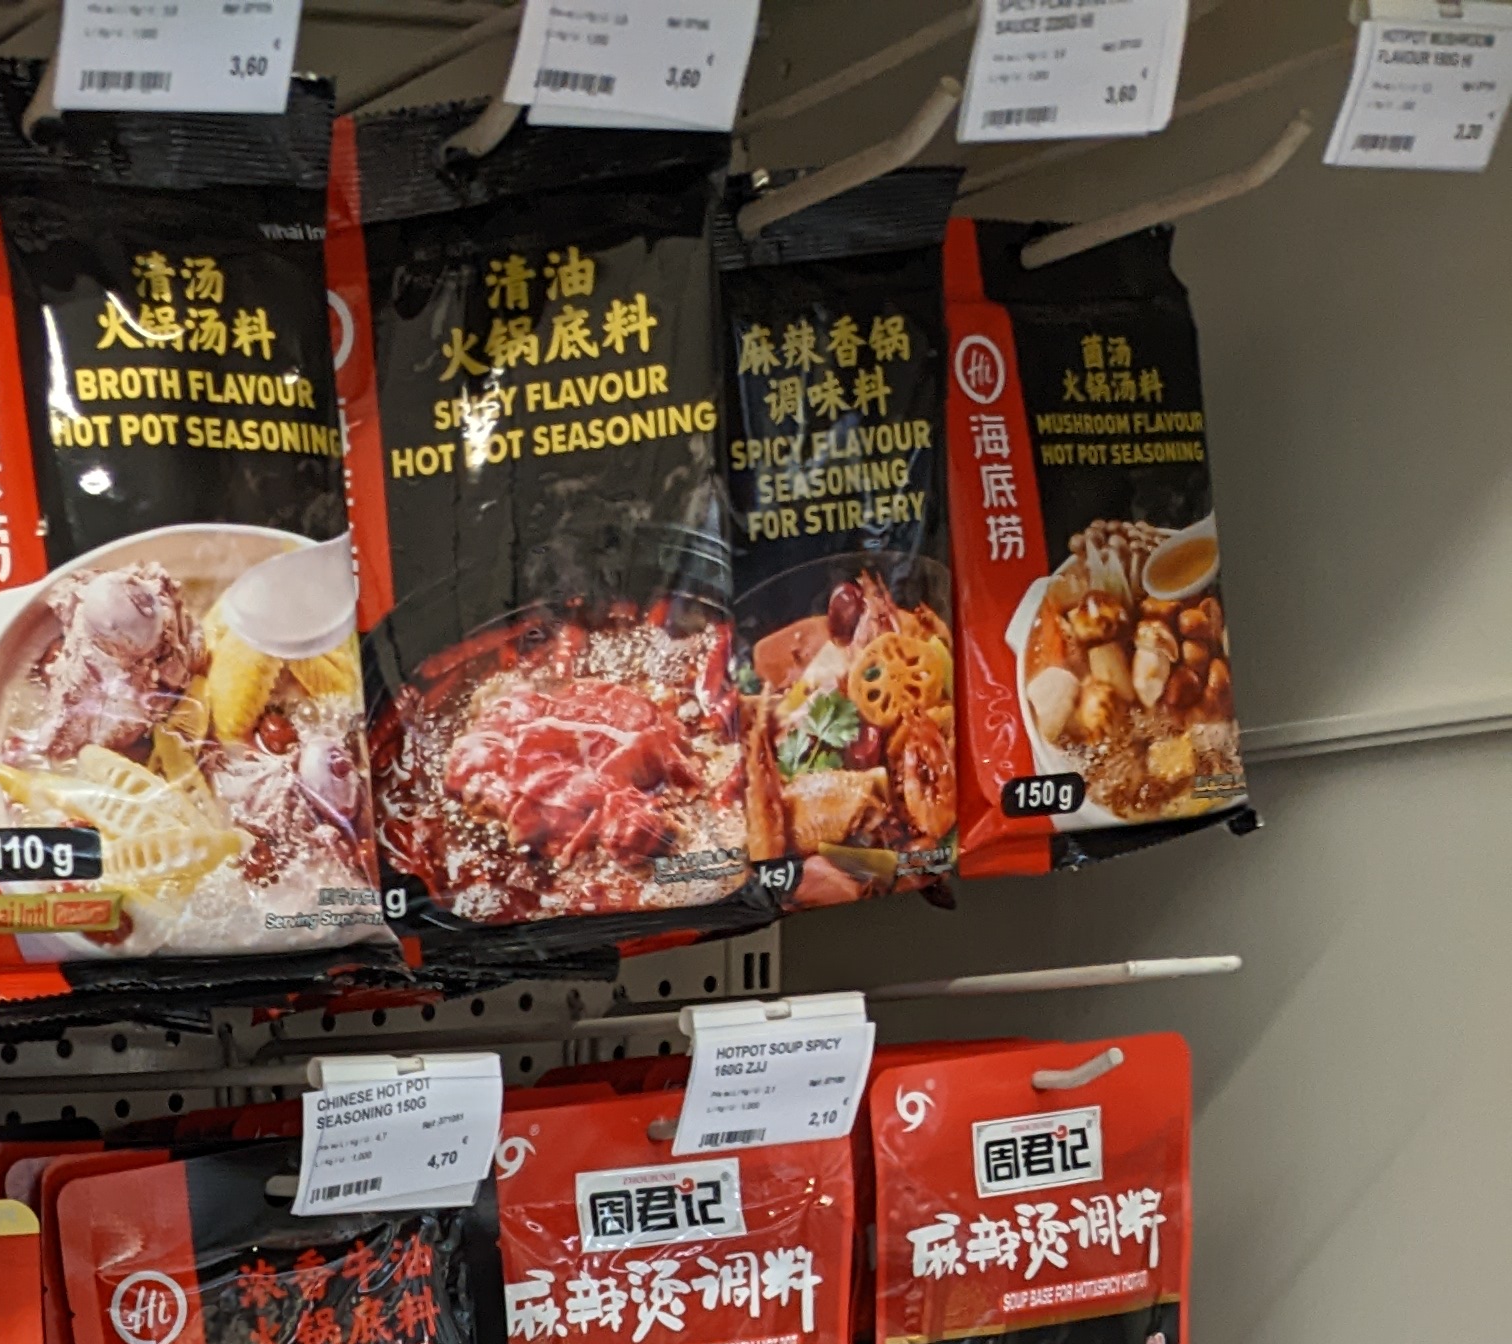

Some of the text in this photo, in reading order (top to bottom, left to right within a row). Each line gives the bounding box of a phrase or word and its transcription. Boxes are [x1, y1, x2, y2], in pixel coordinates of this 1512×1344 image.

[229, 55, 268, 78] 3,60
[665, 67, 701, 89] 3,60
[131, 251, 226, 303] 清汤
[484, 245, 596, 310] 清油
[96, 306, 277, 360] 火锅汤料
[438, 293, 658, 383] 火锅底料
[737, 314, 912, 377] 麻辣香锅
[74, 368, 316, 409] BROTH FLAVOUR
[525, 363, 669, 414] FLAVOUR
[763, 366, 893, 425] 调味料
[50, 413, 343, 458] HOT POT SEASONING
[730, 418, 932, 472] SPICY FLAVOUR
[1036, 410, 1205, 436] MUSHROOM FLAVOUR
[1041, 440, 1205, 466] HOT POT SEASONING
[756, 456, 910, 505] SEASONING
[967, 413, 1027, 563] 海底捞
[1012, 781, 1075, 811] 150 g
[716, 1037, 842, 1060] HOTPOT SOUP SPICY
[316, 1096, 428, 1130] SEASONING 150G
[317, 1077, 431, 1112] CHINESE HOT POT
[808, 1109, 838, 1126] 2,10
[426, 1150, 458, 1170] 4,70
[984, 1125, 1092, 1184] 周君记
[587, 1180, 728, 1238] 周君记
[906, 1188, 1168, 1281] 麻辣烫调料
[505, 1246, 823, 1344] 麻辣烫调料
